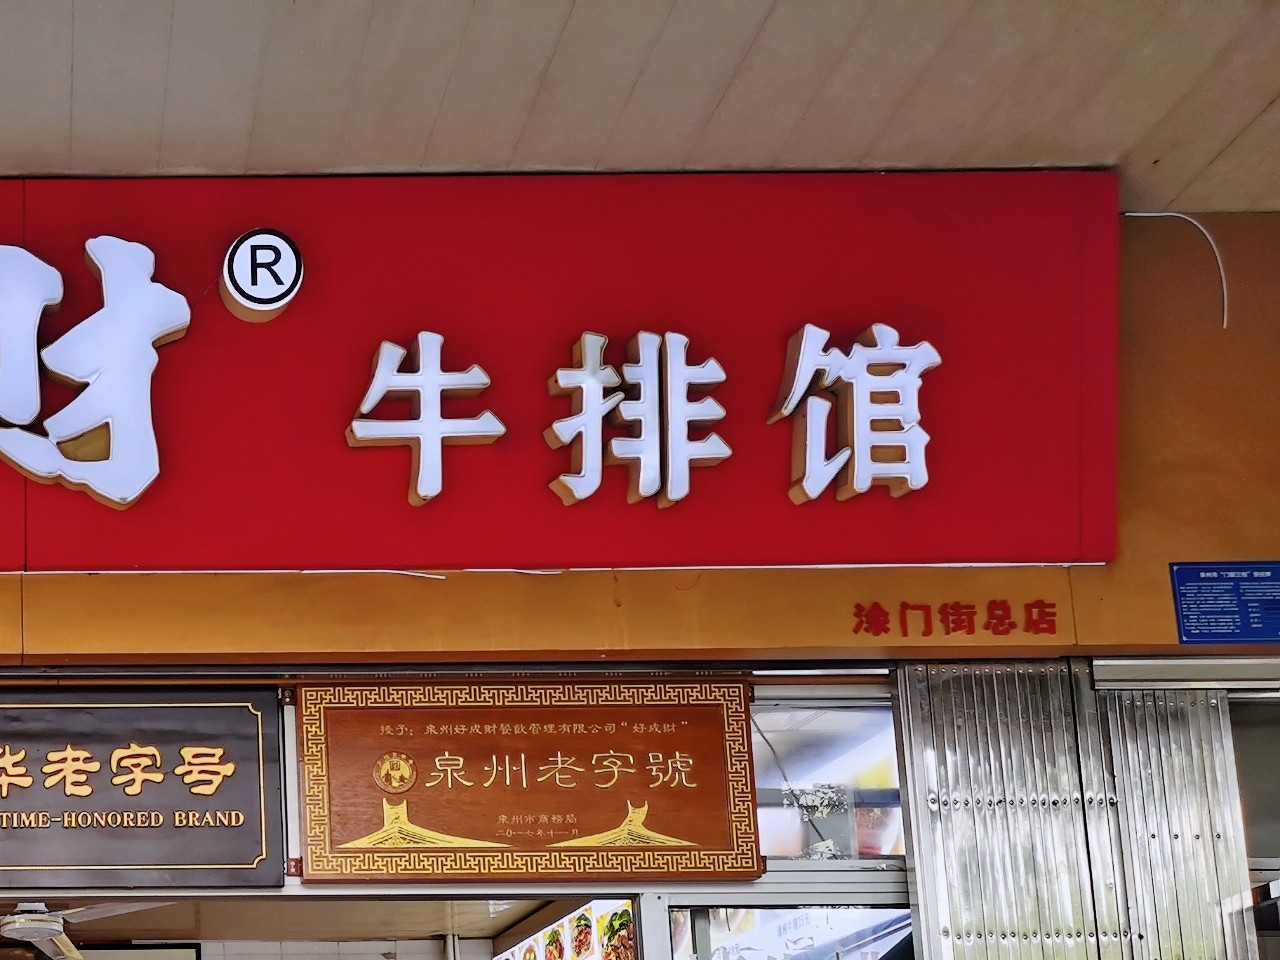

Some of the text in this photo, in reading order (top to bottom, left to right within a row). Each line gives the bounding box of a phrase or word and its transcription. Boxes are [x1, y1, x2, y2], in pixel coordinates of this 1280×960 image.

[345, 323, 942, 508] 牛排馆
[852, 599, 1057, 637] 涂门街总店
[425, 750, 697, 789] 泉州老字號
[174, 810, 244, 827] BRAND
